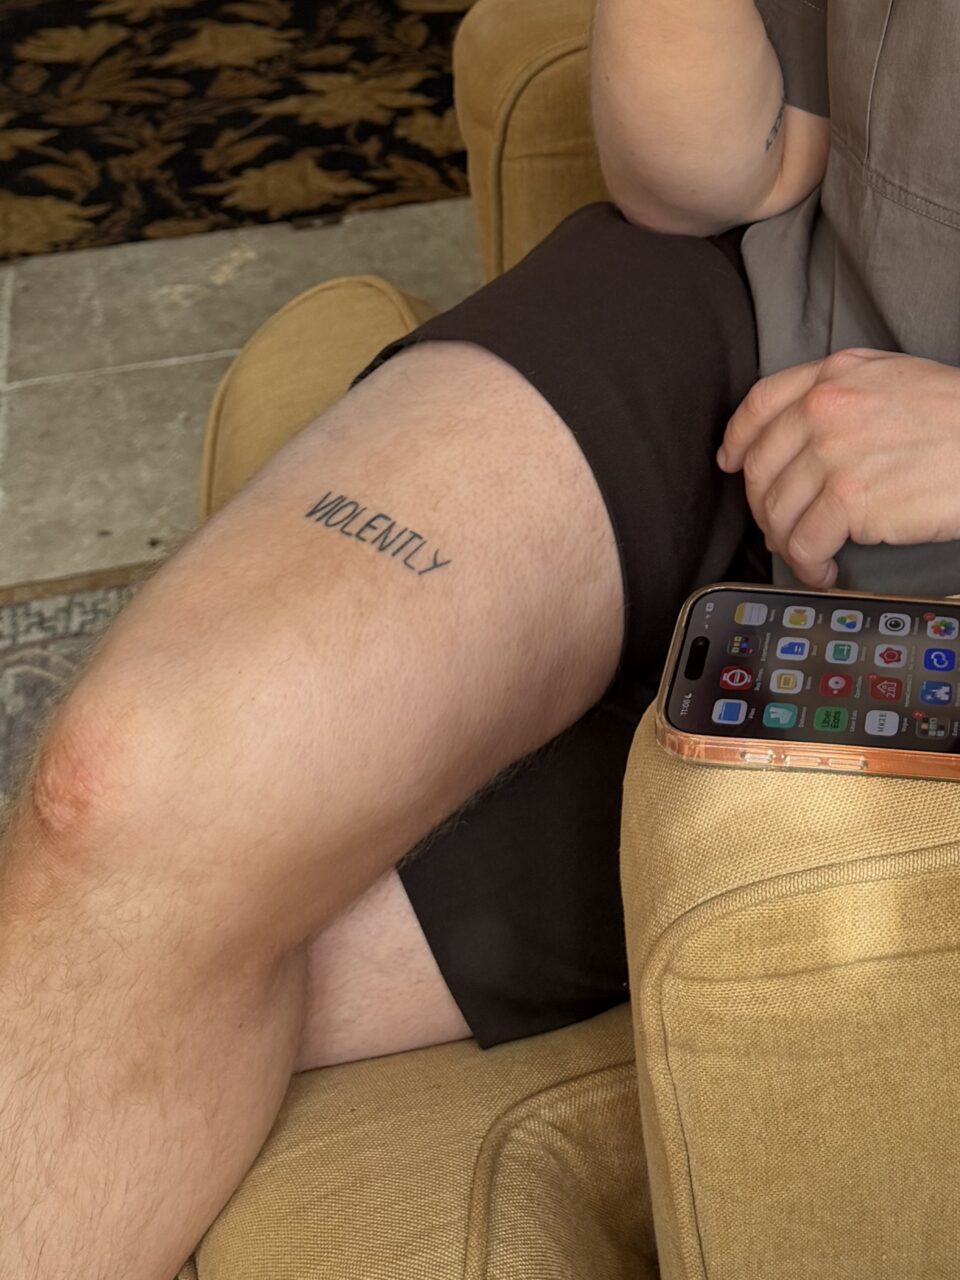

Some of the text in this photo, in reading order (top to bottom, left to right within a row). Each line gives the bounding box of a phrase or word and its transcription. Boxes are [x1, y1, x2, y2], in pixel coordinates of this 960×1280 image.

[305, 490, 451, 575] VIOLENTLY
[821, 710, 832, 728] Uber
[830, 710, 841, 729] Eats
